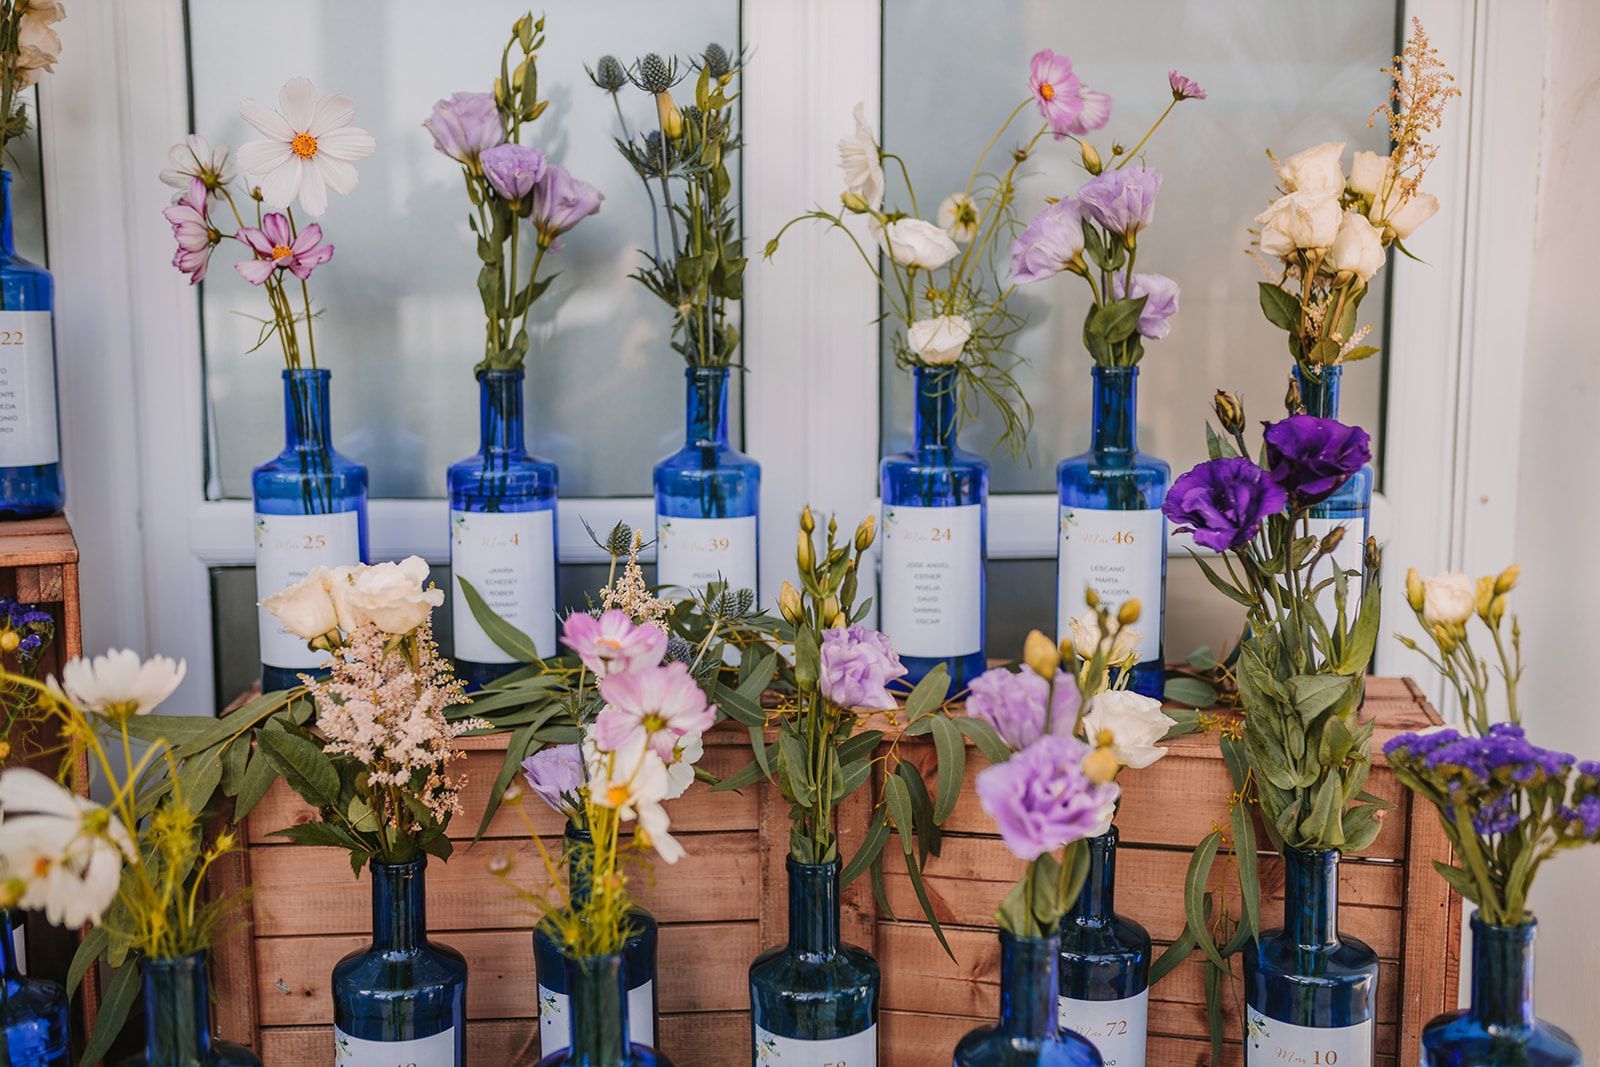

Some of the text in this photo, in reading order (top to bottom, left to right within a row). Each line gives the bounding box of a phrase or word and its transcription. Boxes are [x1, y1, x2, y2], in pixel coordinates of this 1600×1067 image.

[1, 331, 24, 345] 22
[303, 535, 326, 549] 25
[509, 530, 519, 545] 4
[930, 528, 951, 543] 24
[1112, 530, 1135, 544] 46
[709, 537, 729, 552] 39
[1105, 1020, 1128, 1037] 72
[1313, 1049, 1338, 1066] 10
